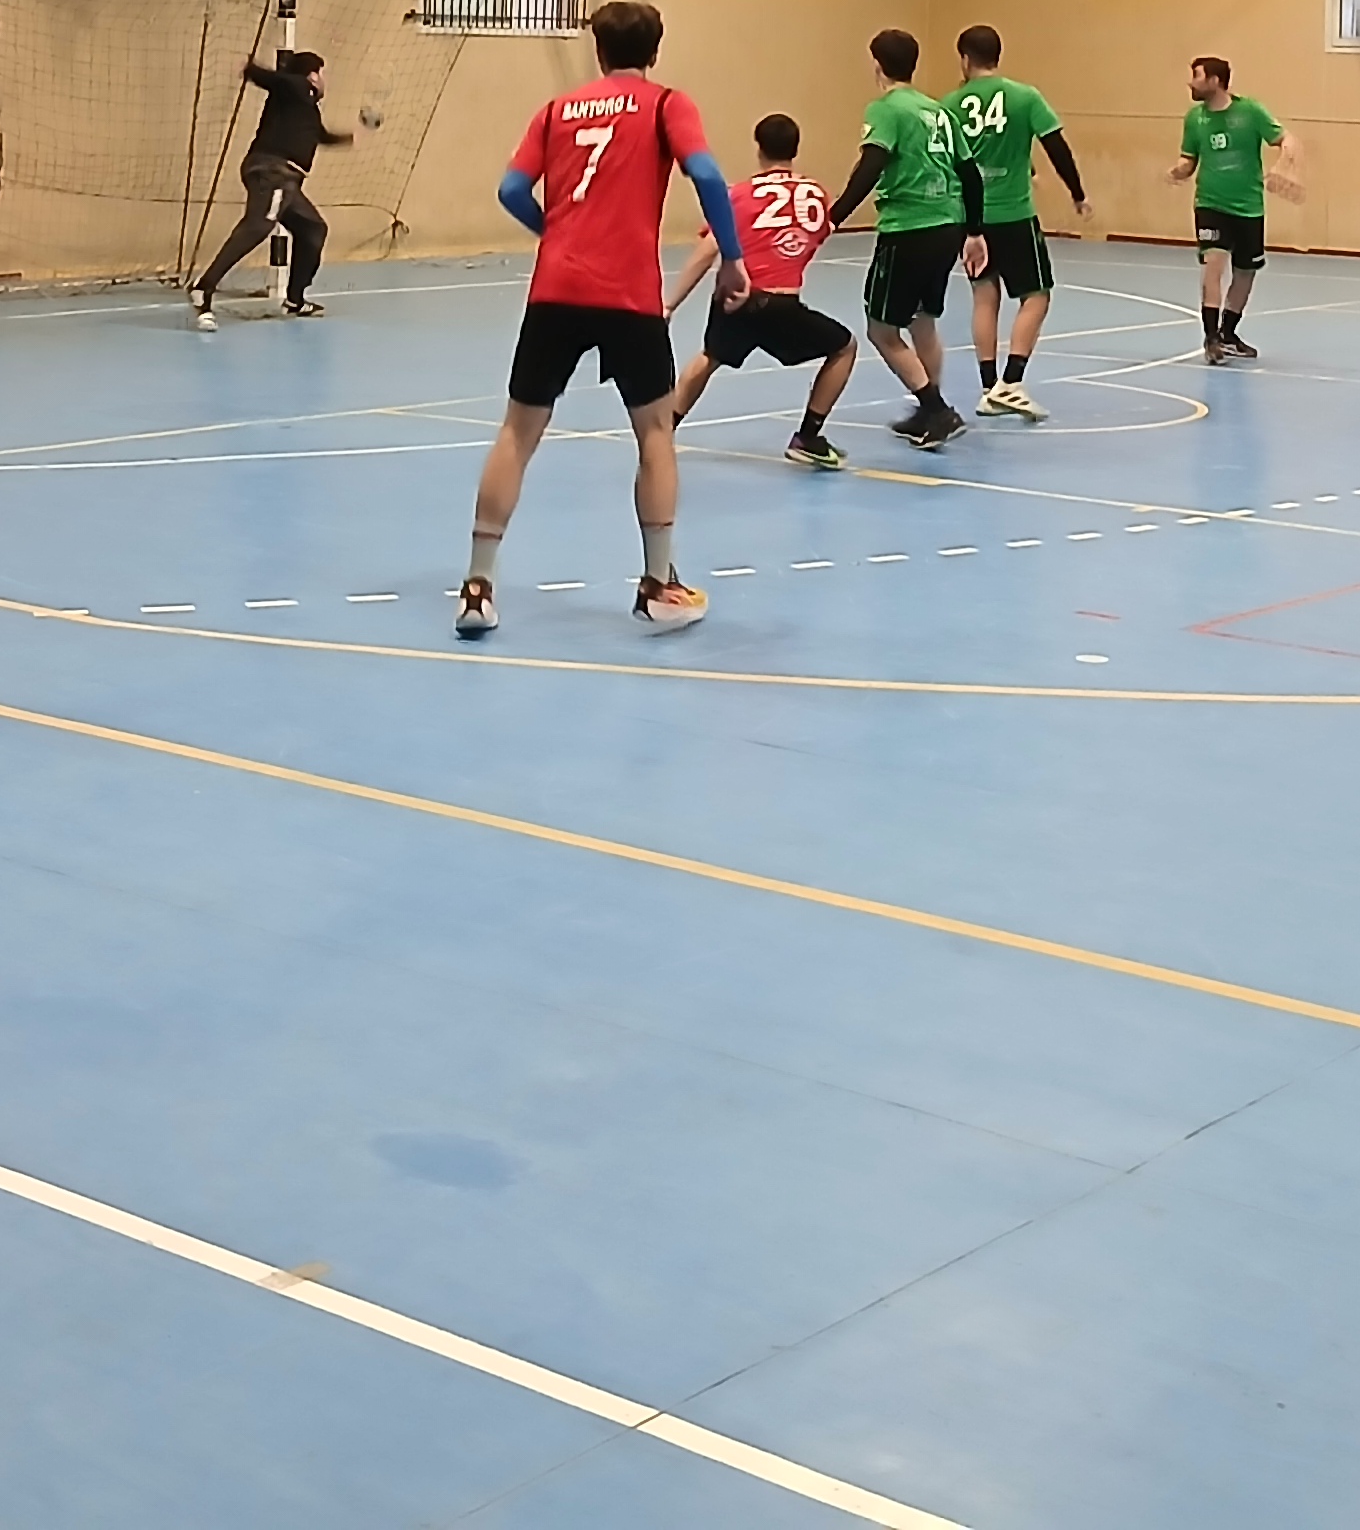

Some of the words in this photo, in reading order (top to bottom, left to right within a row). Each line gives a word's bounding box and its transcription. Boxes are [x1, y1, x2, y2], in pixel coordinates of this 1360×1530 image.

[960, 90, 1008, 137] 34
[572, 125, 614, 202] 7
[751, 183, 825, 232] 26
